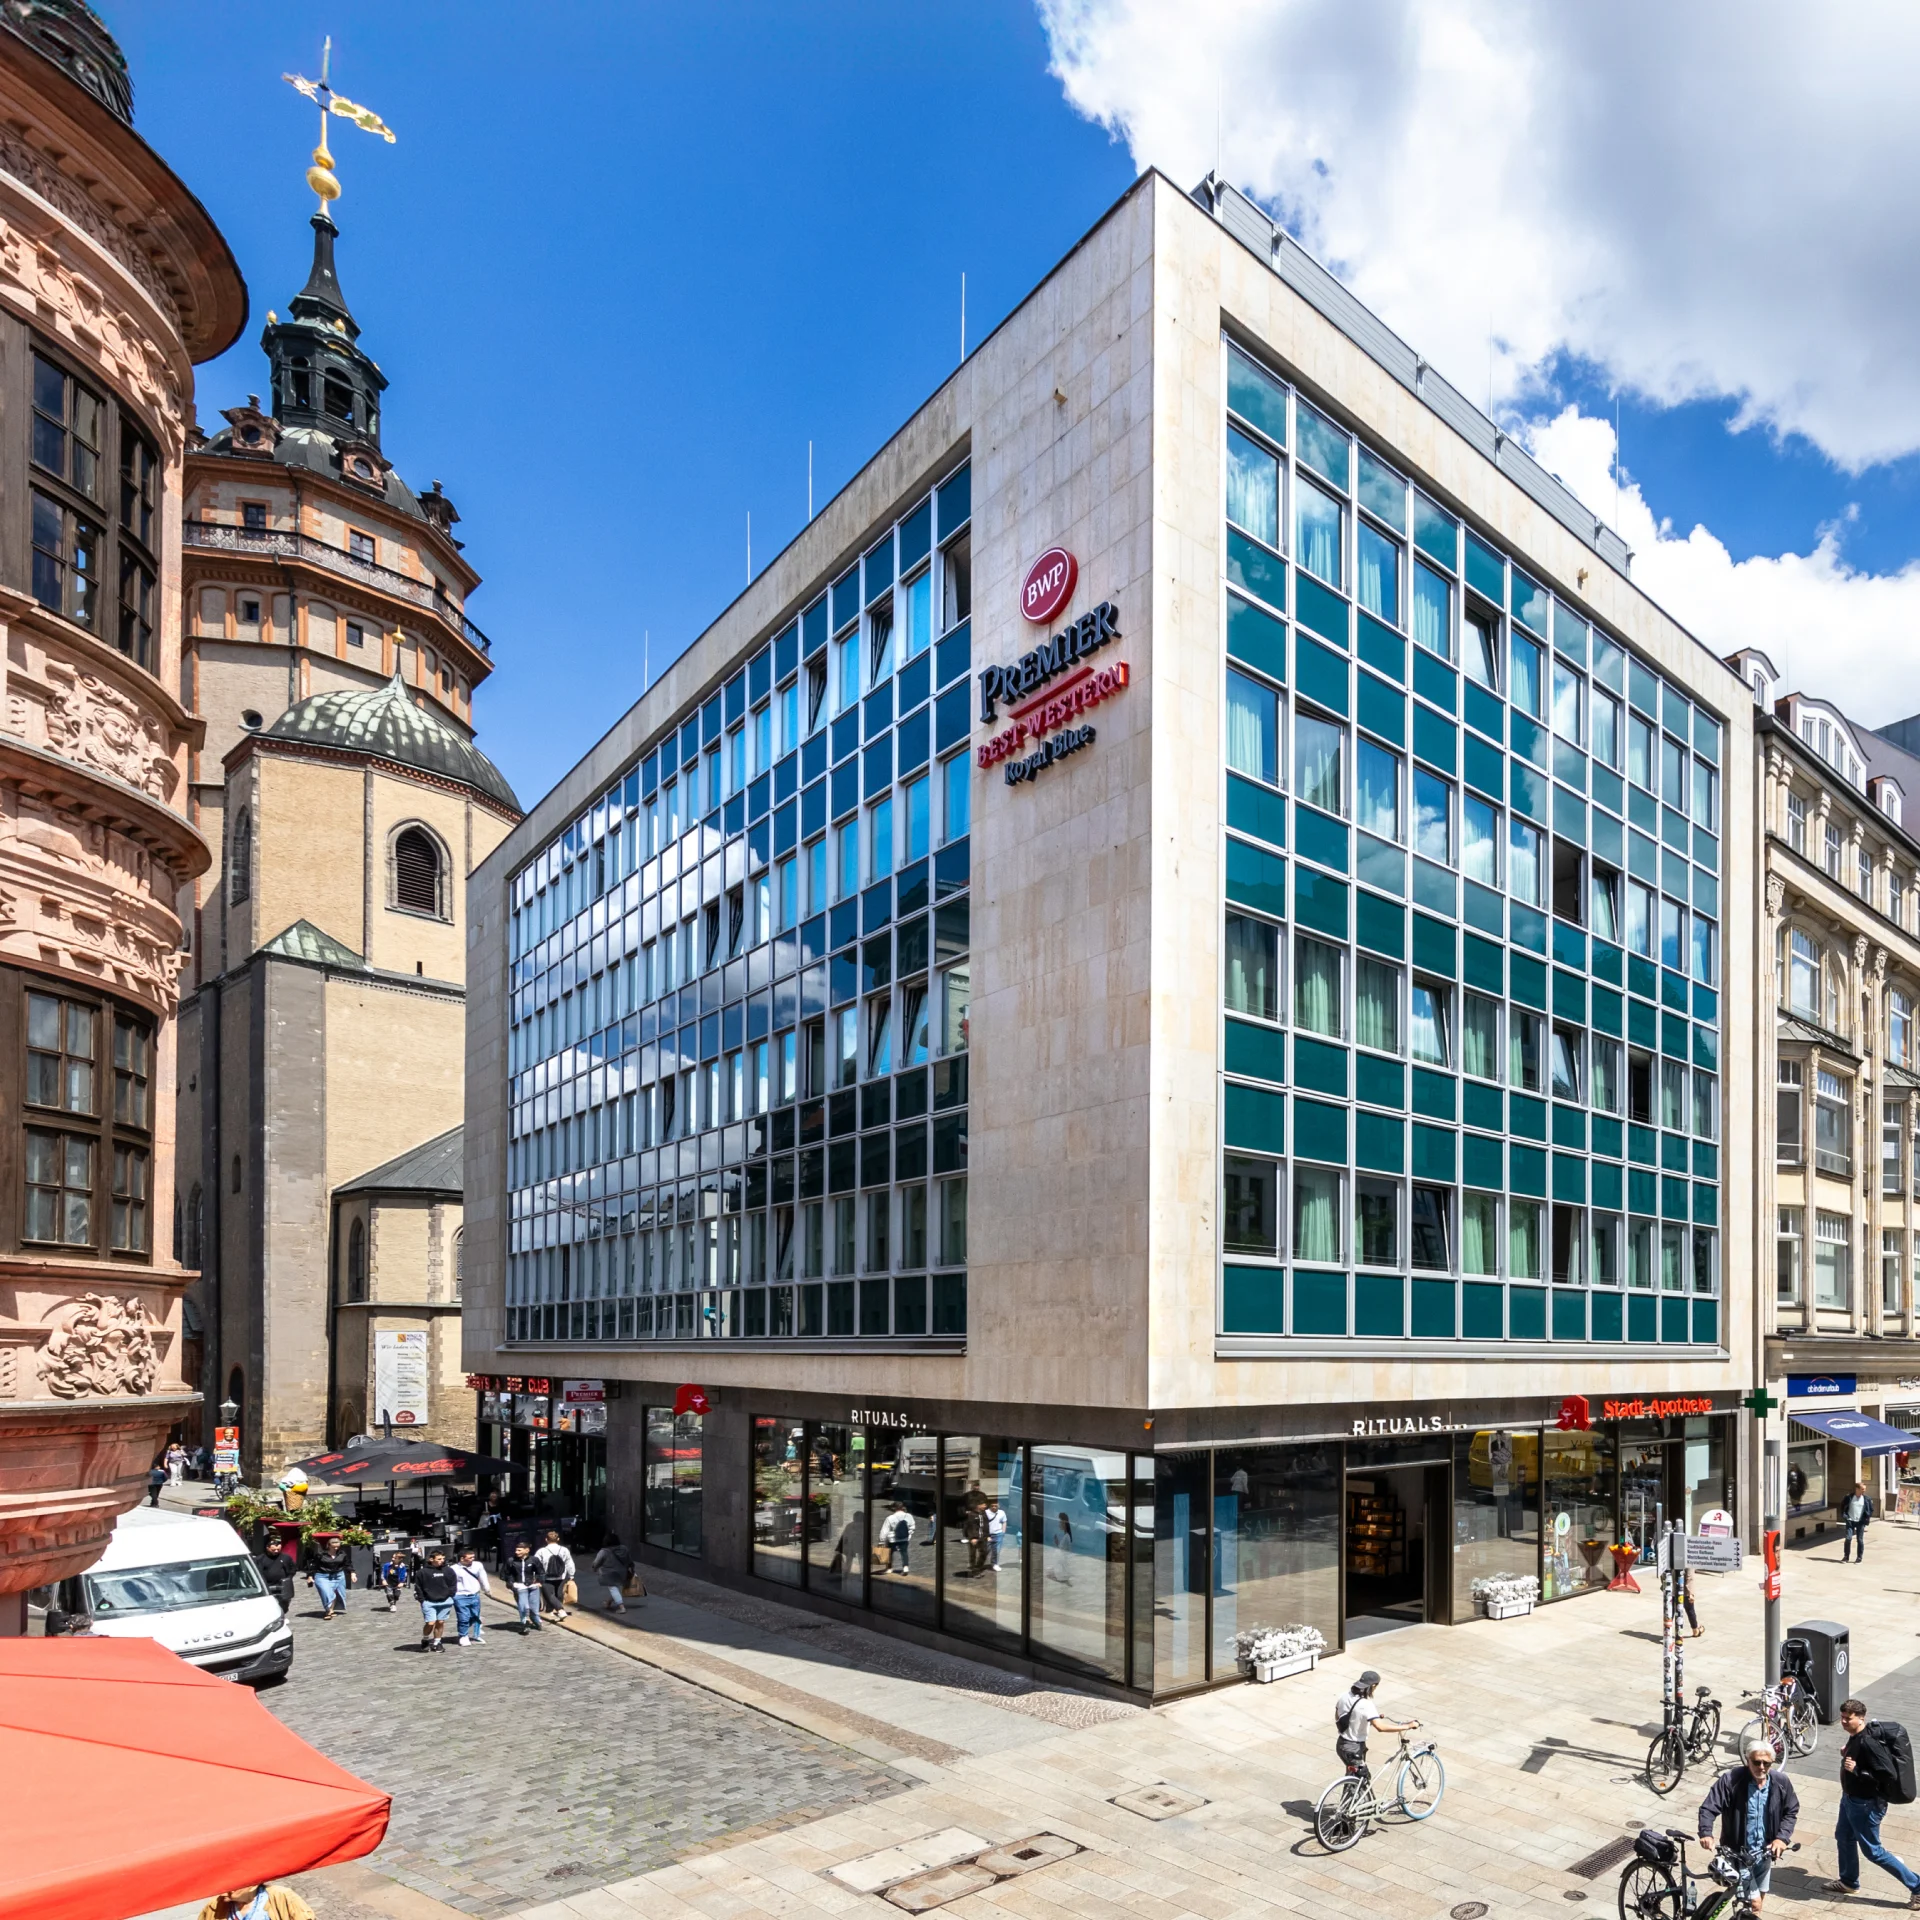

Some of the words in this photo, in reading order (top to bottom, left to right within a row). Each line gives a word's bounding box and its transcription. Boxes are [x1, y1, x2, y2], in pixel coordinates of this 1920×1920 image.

[1027, 561, 1064, 607] BWP
[978, 600, 1122, 725] PREMIER
[977, 722, 1027, 769] BEST
[1026, 660, 1130, 739] WESTERN
[1004, 741, 1047, 786] Royal
[1051, 724, 1097, 761] Blue
[528, 1377, 549, 1394] CLUB
[1603, 1396, 1713, 1419] Stadt-Apotheke
[392, 1458, 466, 1473] Coca-Cola
[184, 1630, 234, 1645] IVECO
